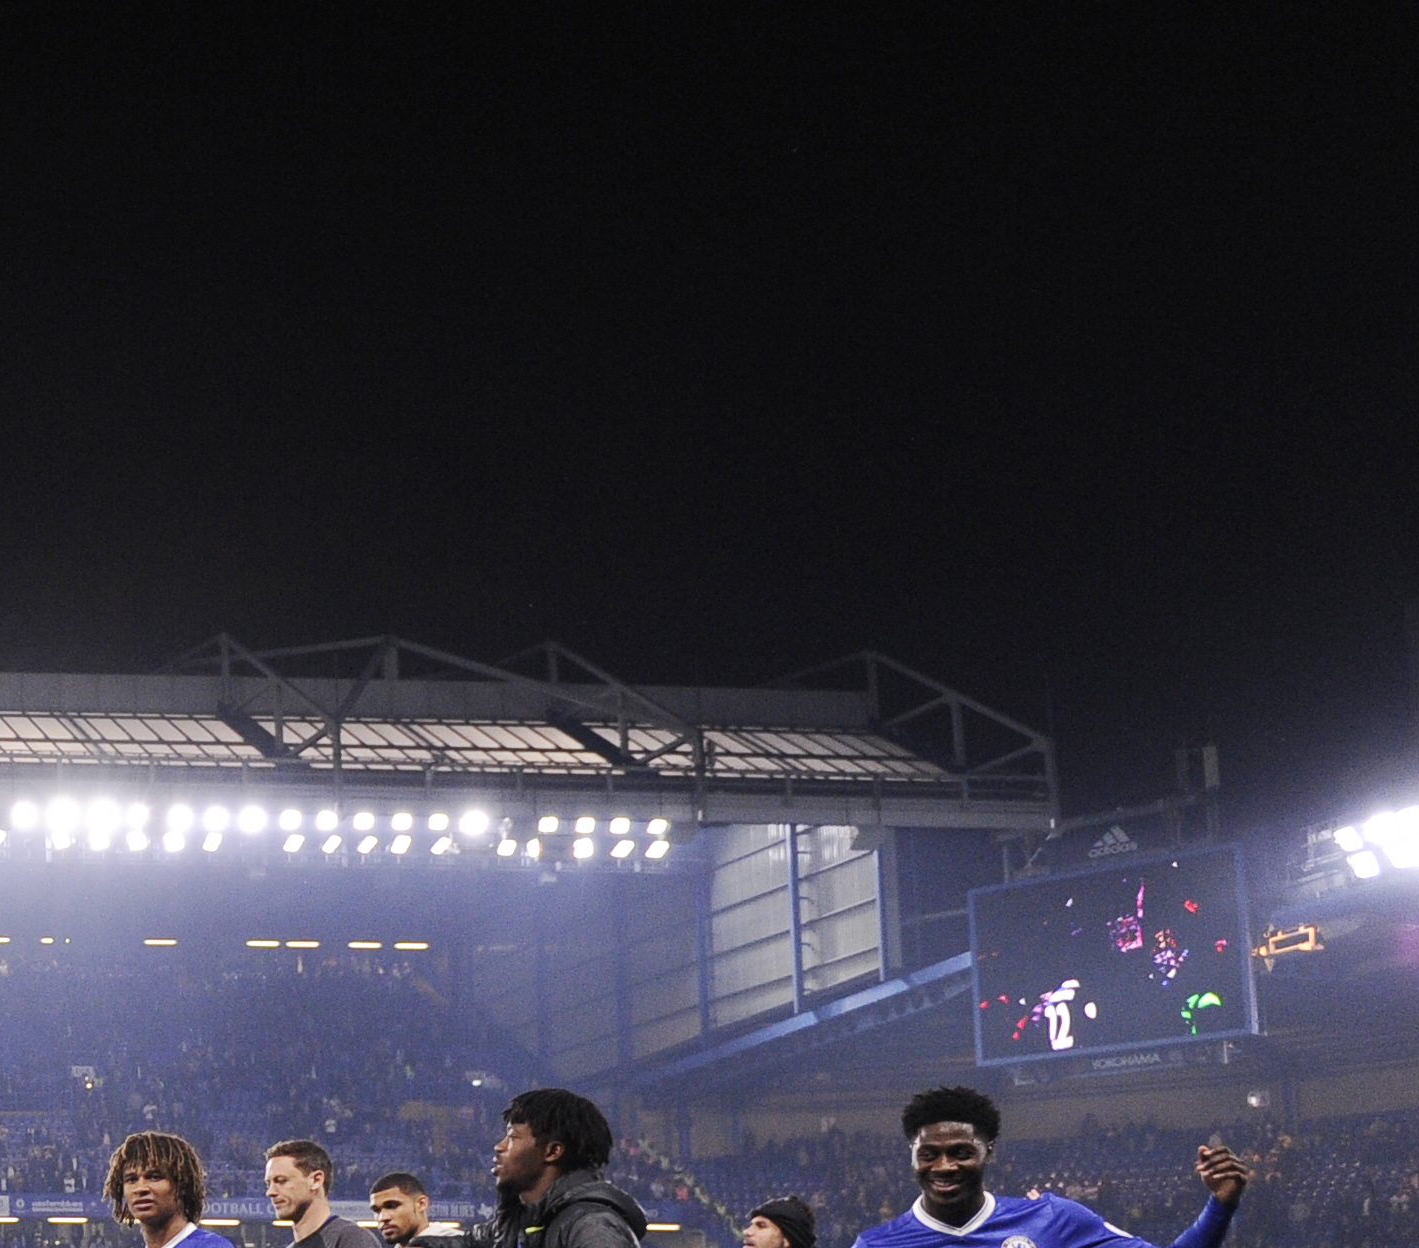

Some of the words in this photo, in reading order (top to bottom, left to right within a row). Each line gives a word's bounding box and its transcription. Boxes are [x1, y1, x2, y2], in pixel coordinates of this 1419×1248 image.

[1044, 1002, 1074, 1050] 12
[1092, 1053, 1161, 1069] YOKOHAMA
[202, 1202, 264, 1214] OOTBALL
